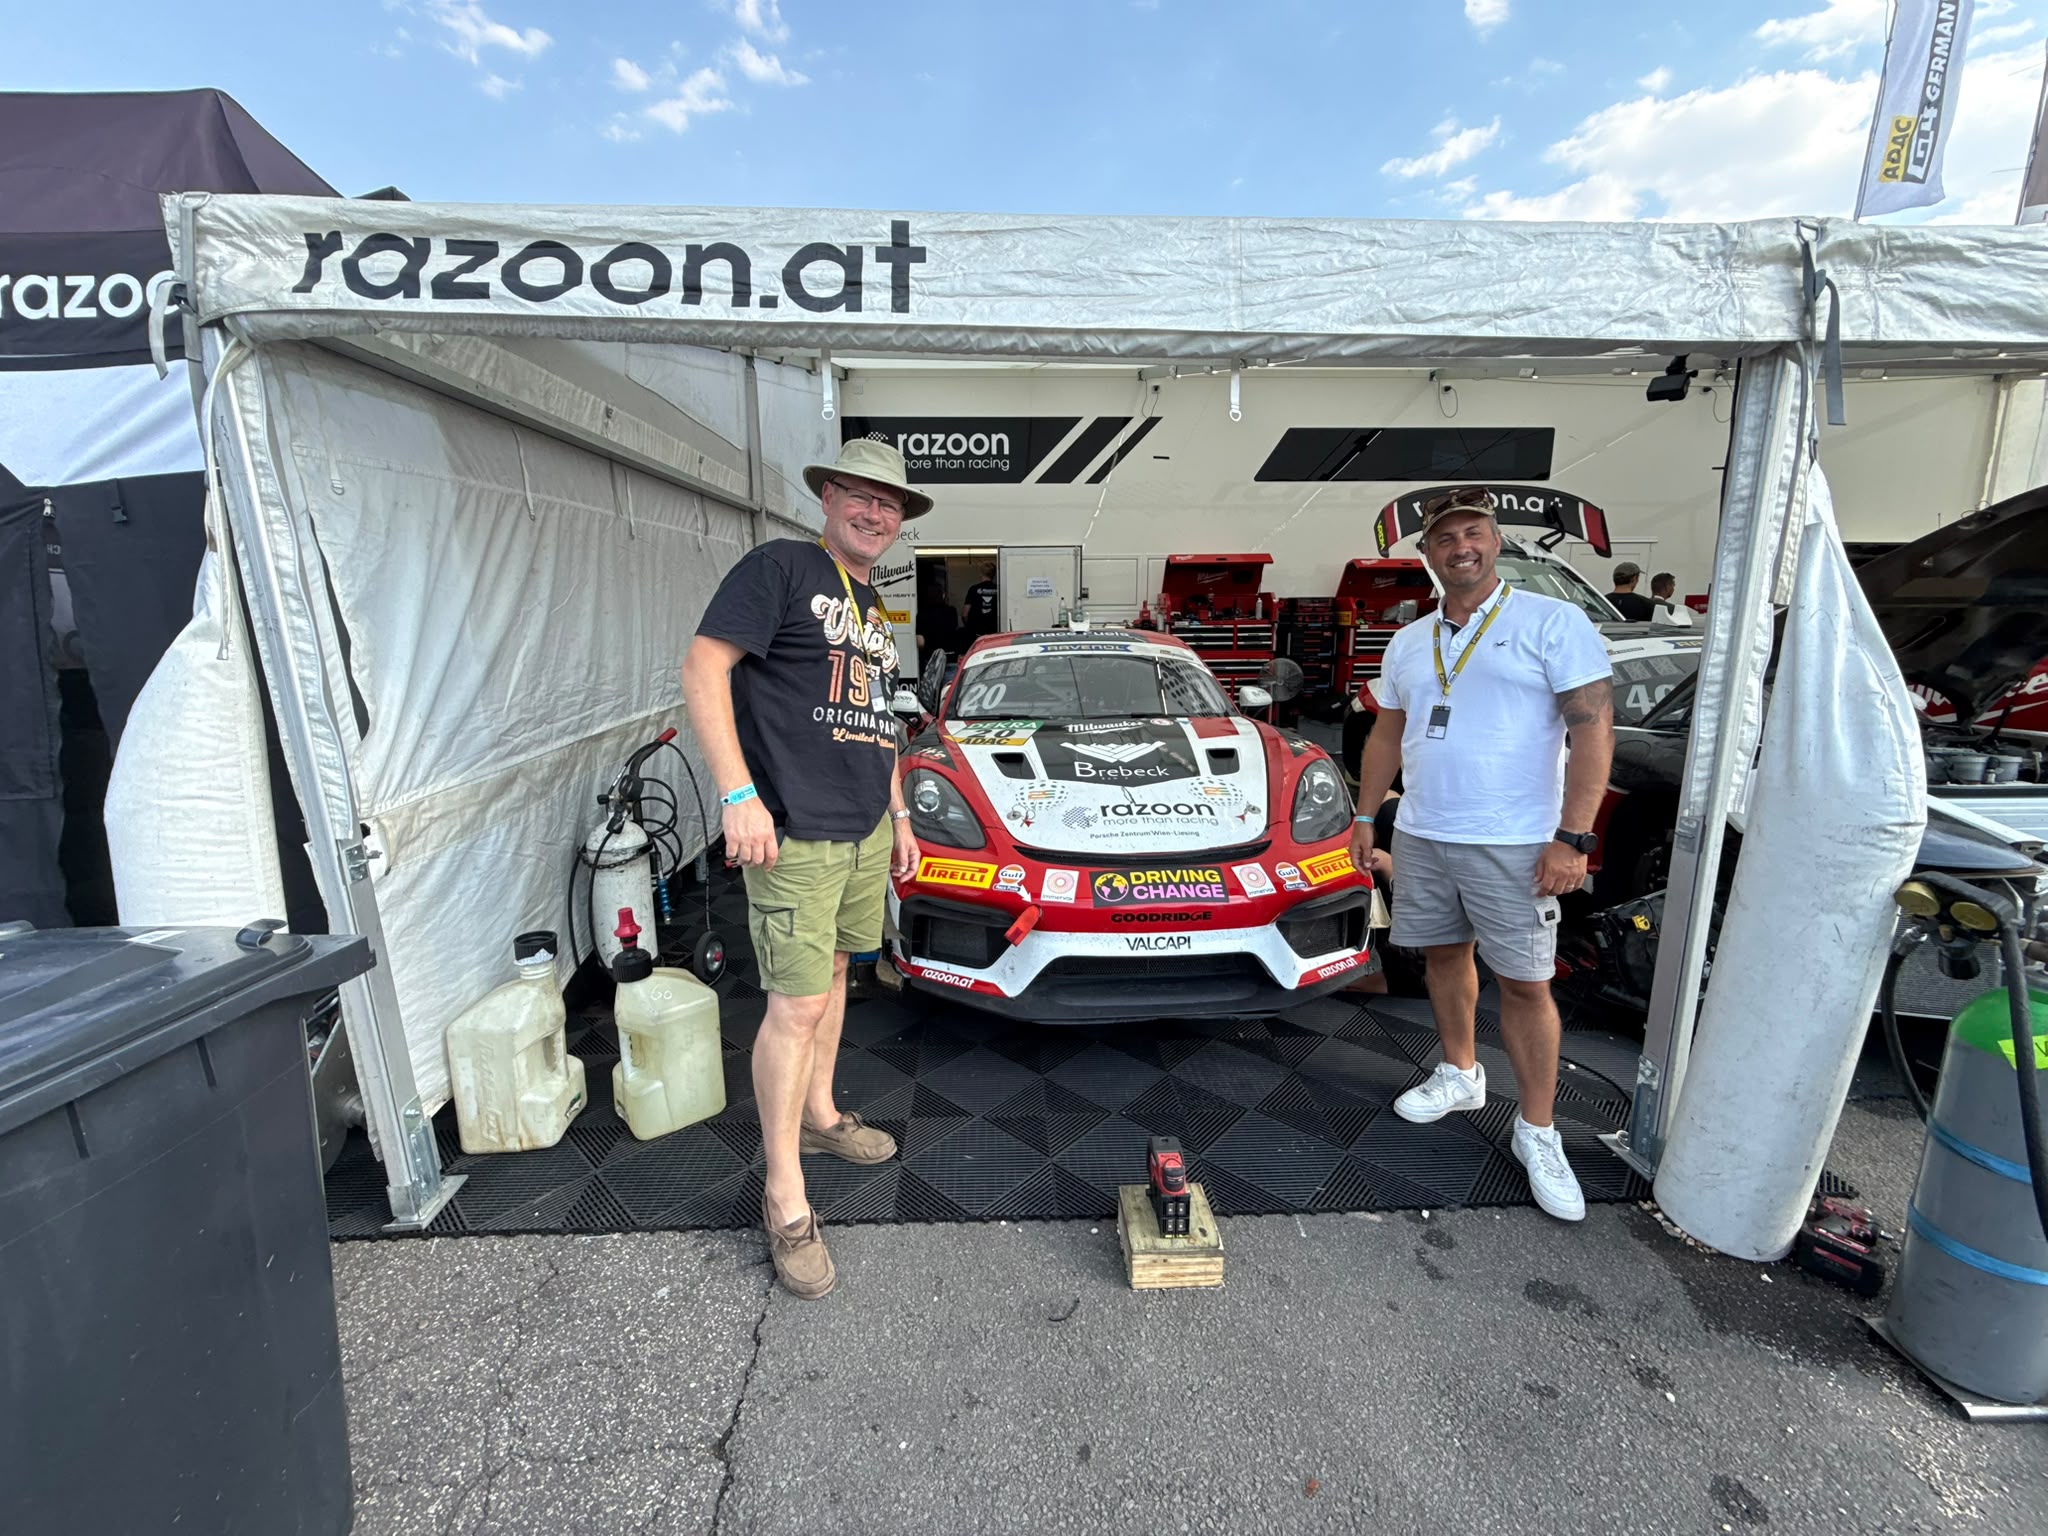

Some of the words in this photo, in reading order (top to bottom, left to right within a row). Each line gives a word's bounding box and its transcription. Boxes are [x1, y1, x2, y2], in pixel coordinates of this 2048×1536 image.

[1883, 119, 1911, 179] ADAC
[291, 220, 927, 313] razoon.at
[897, 433, 1009, 455] razoon
[936, 458, 965, 469] than
[969, 457, 1009, 471] racing
[961, 684, 1006, 715] 20
[813, 706, 878, 730] ORIGINA
[879, 719, 897, 737] PAR
[967, 721, 1038, 729] DEKRA
[969, 729, 1016, 738] 20
[1074, 761, 1170, 777] Brebeck
[1100, 803, 1216, 817] razoon
[1103, 818, 1138, 826] more
[1142, 816, 1173, 824] than
[1176, 816, 1219, 826] racing
[922, 862, 989, 883] PIRELLI
[1278, 868, 1298, 877] Gulf
[1306, 852, 1352, 878] PIRELL
[1001, 870, 1023, 878] Gulf
[1130, 870, 1221, 884] DRIVING
[1132, 884, 1225, 899] CHANGE
[1111, 911, 1212, 923] GOODRIDGE
[1125, 936, 1191, 951] VALCAPI
[1317, 956, 1358, 979] razoon.at
[921, 968, 975, 989] razoon.at
